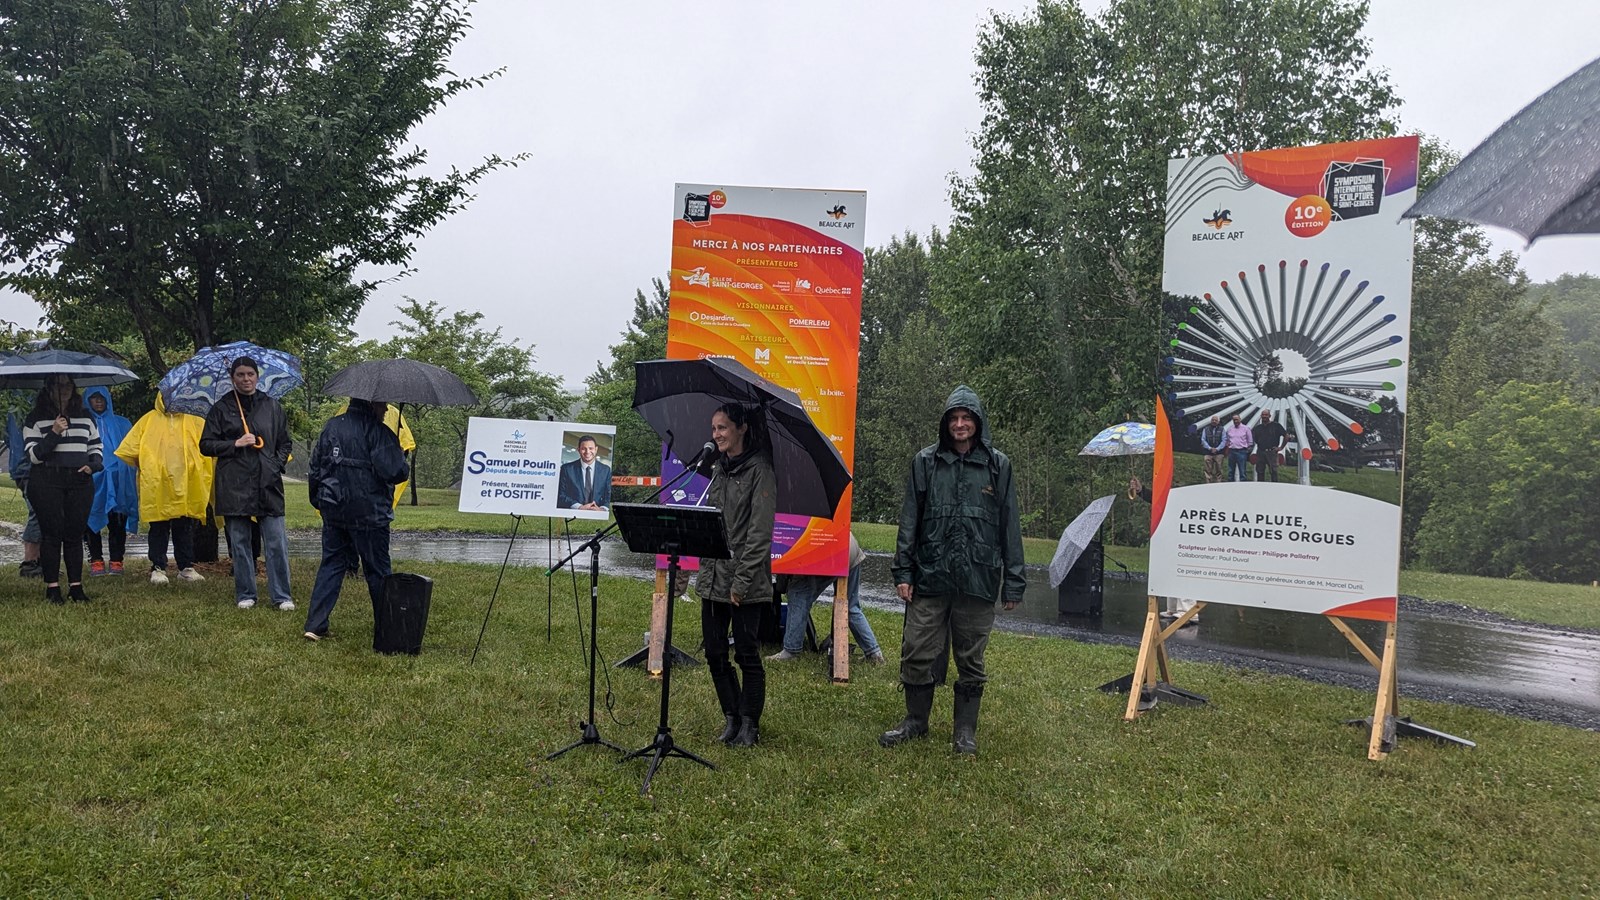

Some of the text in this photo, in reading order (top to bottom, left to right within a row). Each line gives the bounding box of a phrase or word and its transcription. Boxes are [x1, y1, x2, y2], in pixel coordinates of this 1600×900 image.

[1334, 174, 1375, 187] SYMPOSIUM
[1334, 184, 1374, 194] INTERNATIONAL
[1339, 192, 1374, 201] SCULPTURE
[818, 220, 855, 229] BEAUCE ART
[1292, 221, 1324, 229] ÉDITION
[1192, 231, 1244, 241] BEAUCE ART
[692, 239, 843, 255] MERCI À NOS PARTENAIRES
[736, 257, 799, 268] PRÉSENTATEURS
[711, 281, 764, 290] SAINT-GEORGES
[814, 286, 842, 294] Québec
[736, 302, 794, 311] VISIONNAIRES
[700, 313, 735, 322] Desjardins
[789, 318, 830, 327] POMERLEAU
[740, 334, 787, 344] BÂTISSEURS
[467, 450, 556, 474] Samuel Poulin
[519, 469, 556, 477] Beauce-Sud
[481, 480, 545, 490] Présent, travaillant
[480, 489, 544, 500] et POSITIF.
[1179, 508, 1307, 530] APRÈS LA PLUIE,
[1179, 523, 1355, 546] LES GRANDES ORGUES
